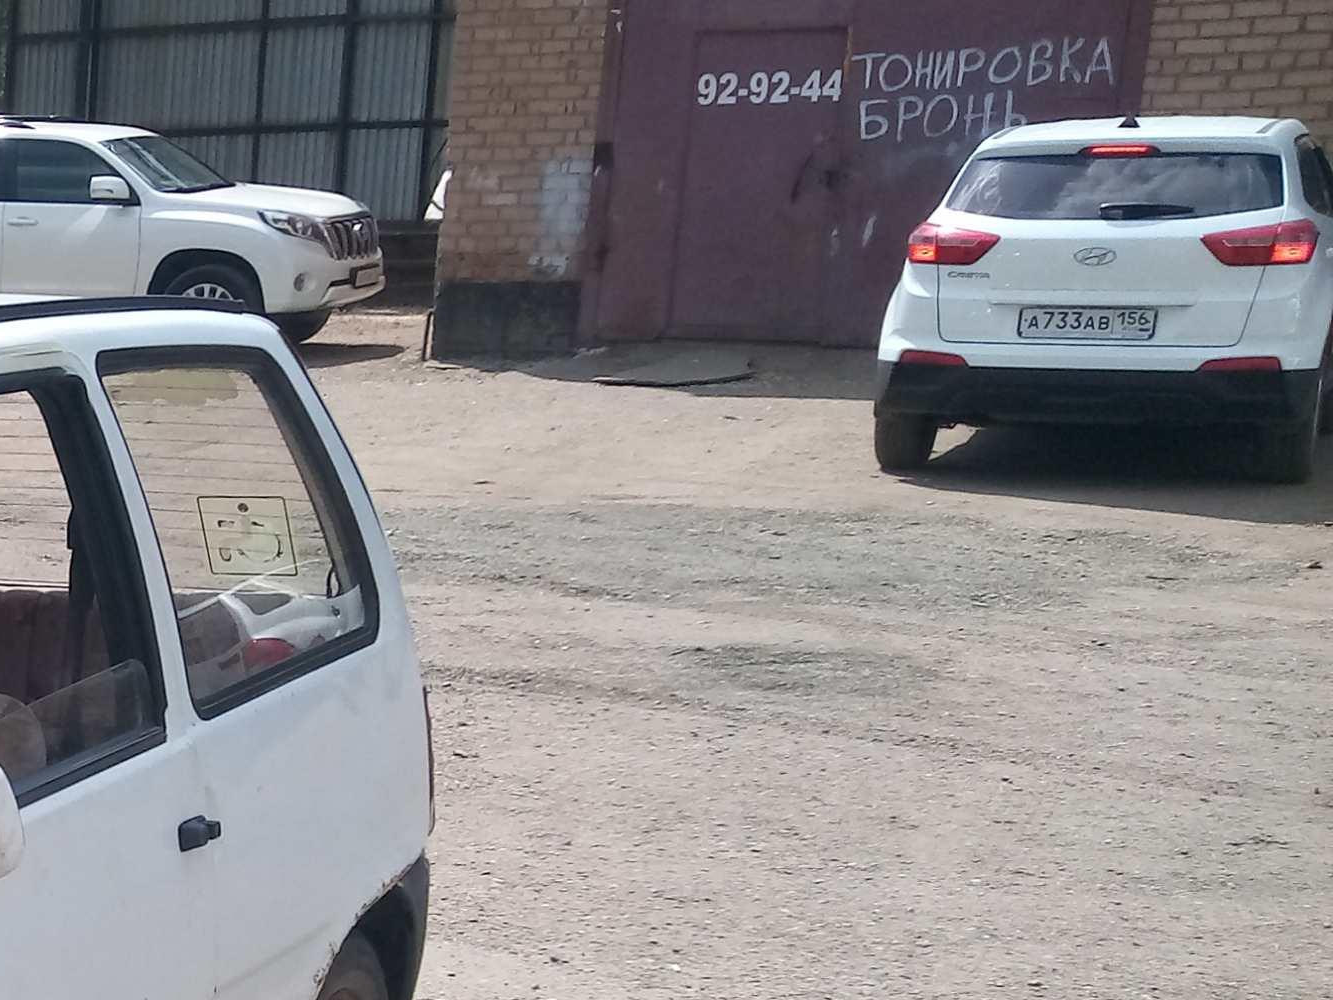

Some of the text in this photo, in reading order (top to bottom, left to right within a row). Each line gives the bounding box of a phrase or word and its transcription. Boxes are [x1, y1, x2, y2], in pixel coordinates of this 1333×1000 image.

[851, 37, 1115, 92] ТОНИРОВКА
[697, 69, 843, 106] 92-92-44
[858, 89, 1030, 142] БРОНЬ
[1027, 312, 1148, 331] А733АВ 156
